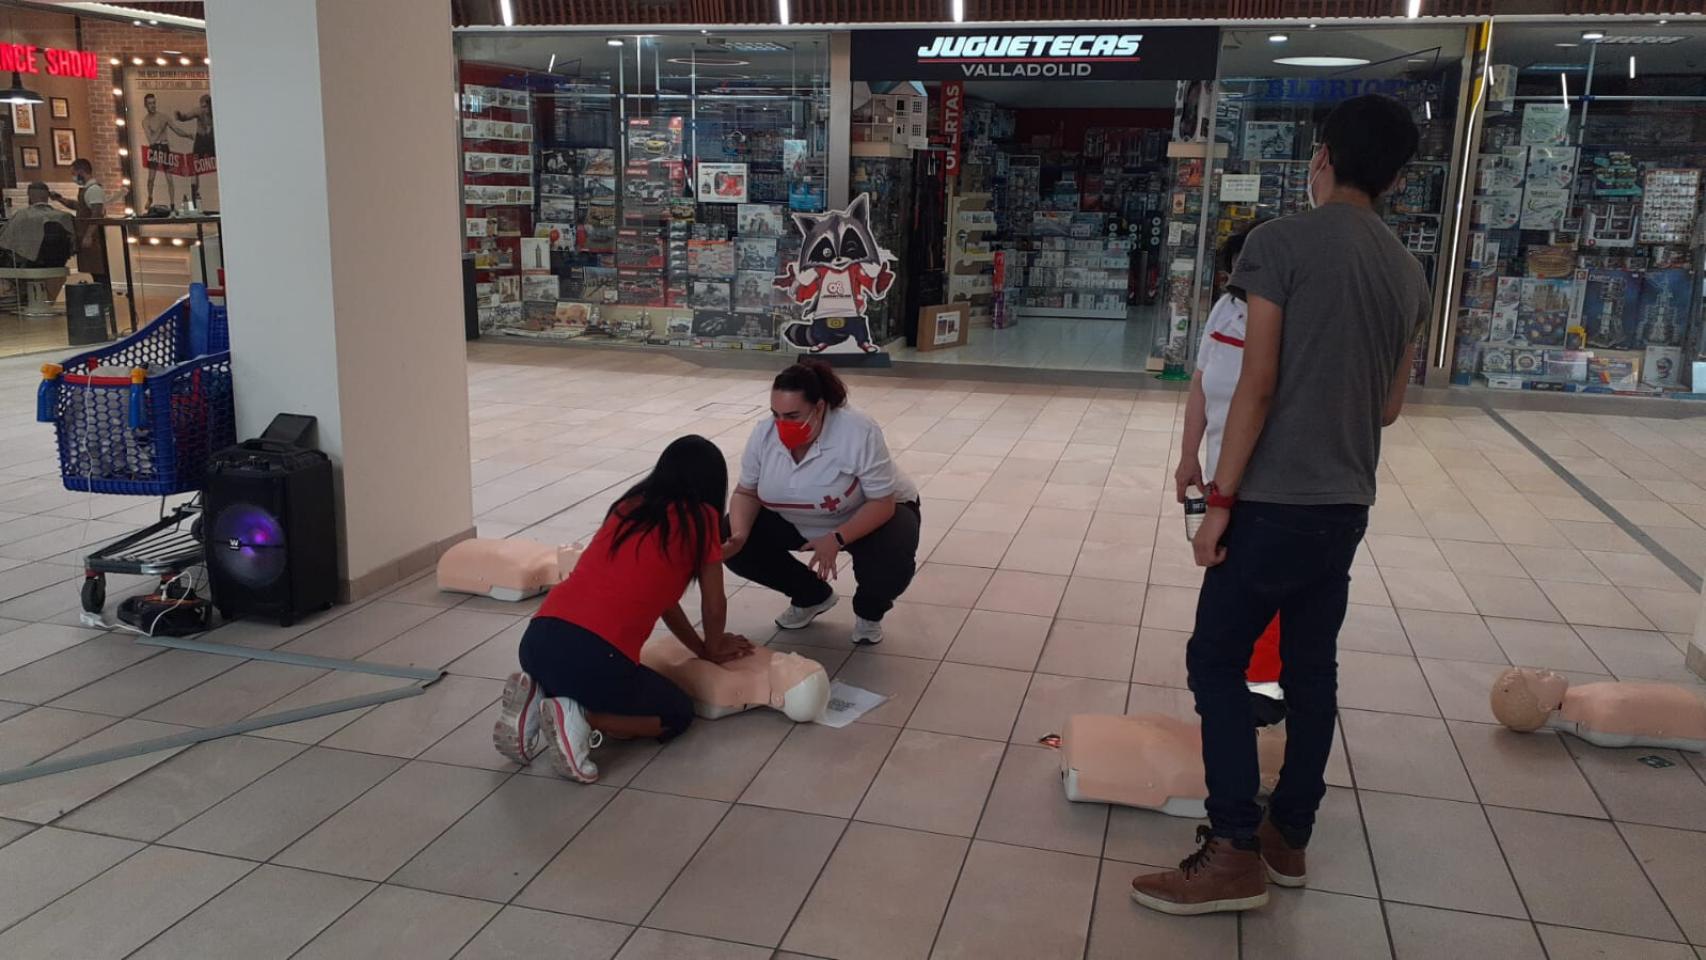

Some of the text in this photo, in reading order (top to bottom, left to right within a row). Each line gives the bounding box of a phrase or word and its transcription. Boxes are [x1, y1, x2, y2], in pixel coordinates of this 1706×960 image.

[917, 34, 1144, 57] JUGUETECAS
[44, 48, 98, 80] SHOW
[960, 63, 1092, 77] VALLADOLID
[146, 148, 180, 168] CARLOS
